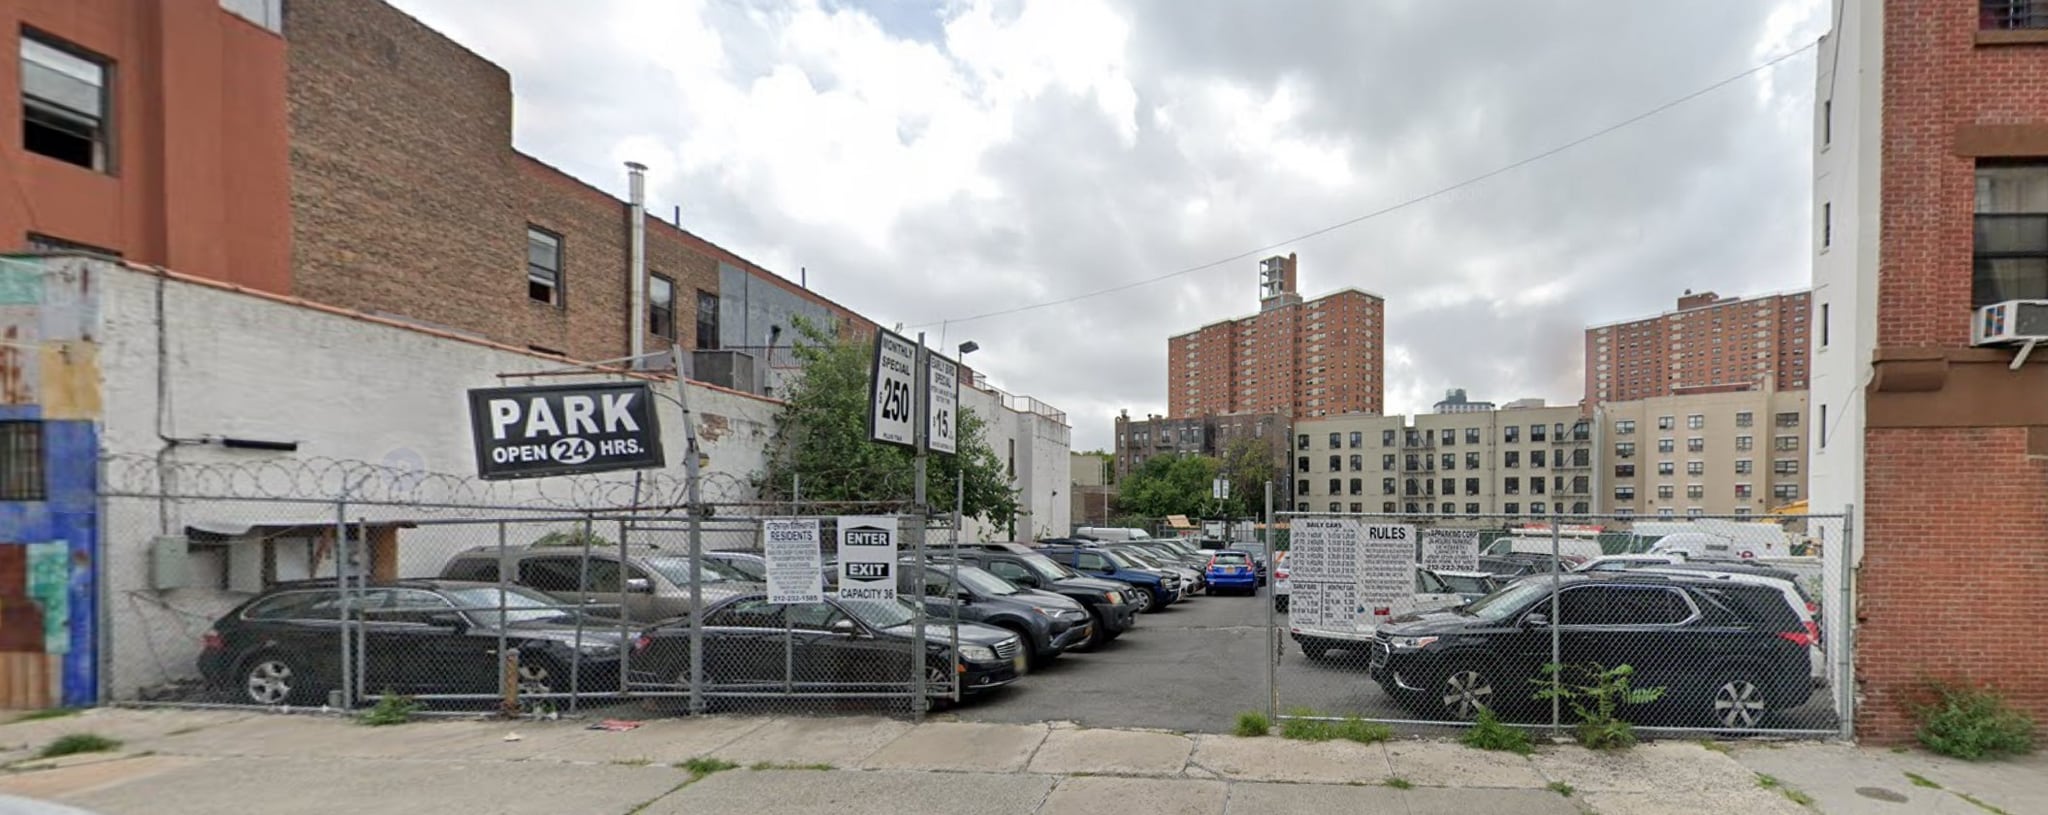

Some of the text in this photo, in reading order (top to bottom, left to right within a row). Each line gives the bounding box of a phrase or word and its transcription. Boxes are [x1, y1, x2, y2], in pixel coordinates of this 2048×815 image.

[883, 338, 913, 358] MONTHLY
[882, 355, 911, 376] SPECIAL
[489, 393, 640, 440] PARK
[492, 438, 645, 464] OPEN 24 HRS.
[770, 530, 812, 541] RESIDENTS
[847, 533, 888, 545] ENTER
[1369, 527, 1406, 540] RULES
[849, 564, 885, 576] EXIT
[840, 588, 894, 600] CAPACITY 36
